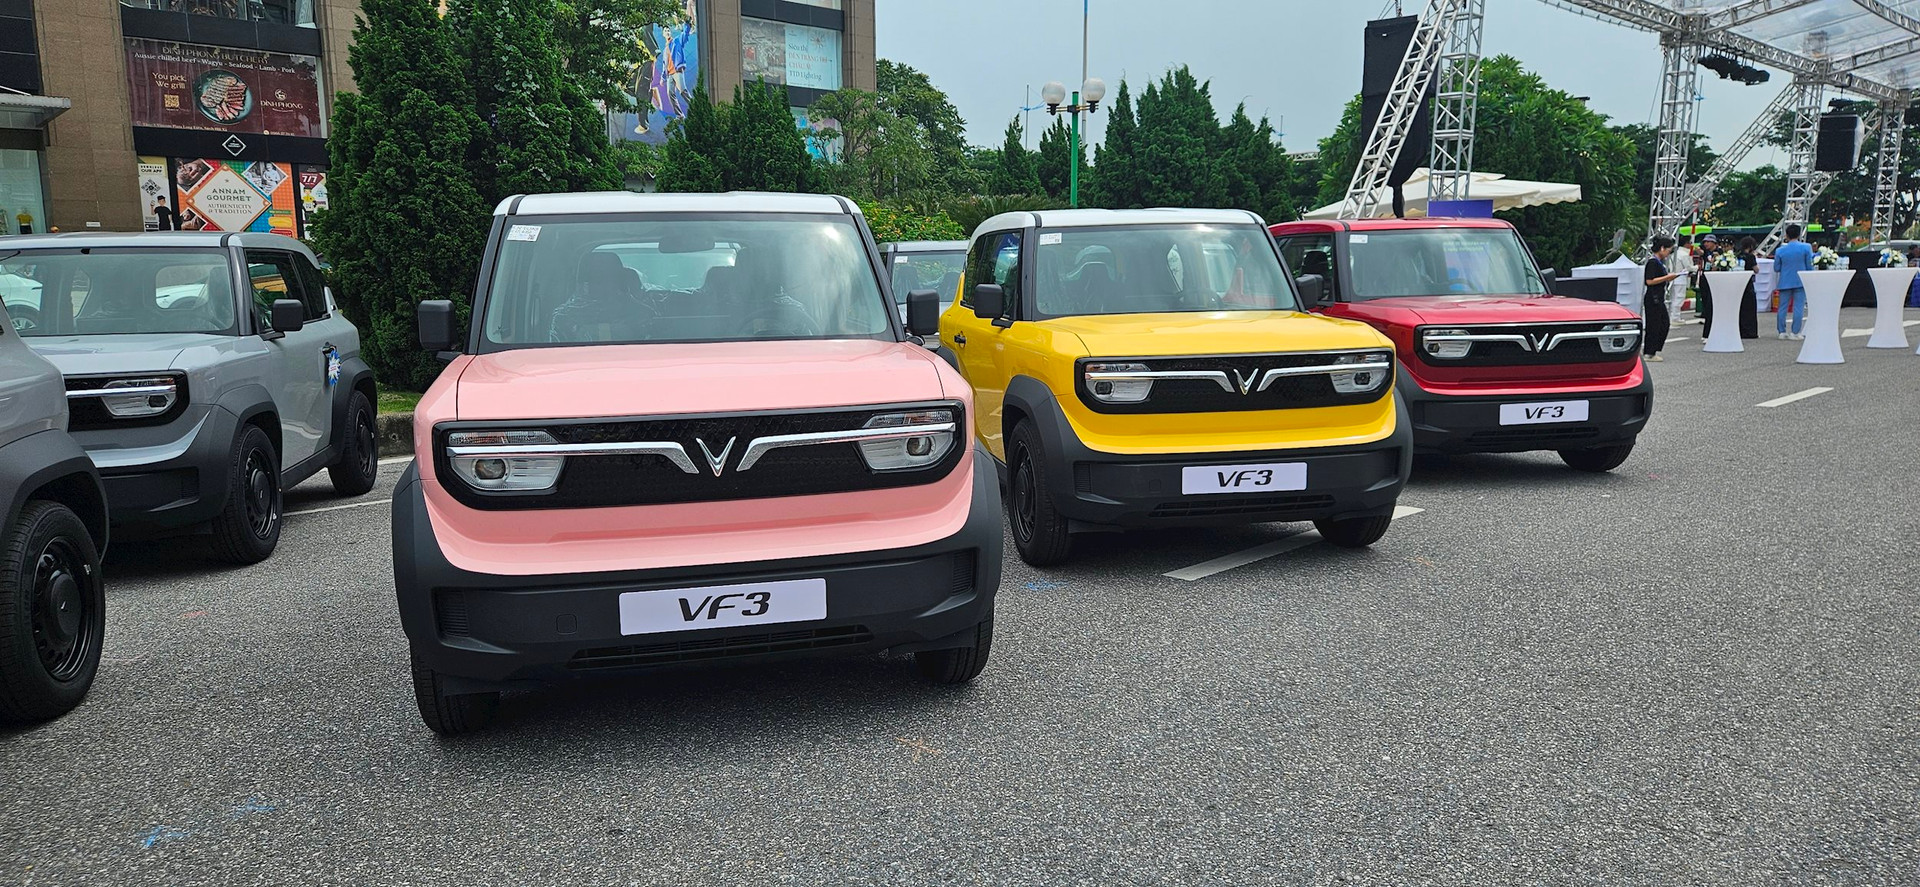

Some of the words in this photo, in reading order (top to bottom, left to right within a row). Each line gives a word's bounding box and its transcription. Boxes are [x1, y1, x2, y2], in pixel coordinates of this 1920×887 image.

[134, 52, 156, 60] Aussie
[158, 54, 180, 62] chilled
[202, 58, 222, 67] Wagyu
[228, 62, 254, 70] Seafood
[1524, 406, 1565, 420] VF3
[1217, 469, 1274, 488] VF3
[678, 591, 772, 622] VF3
